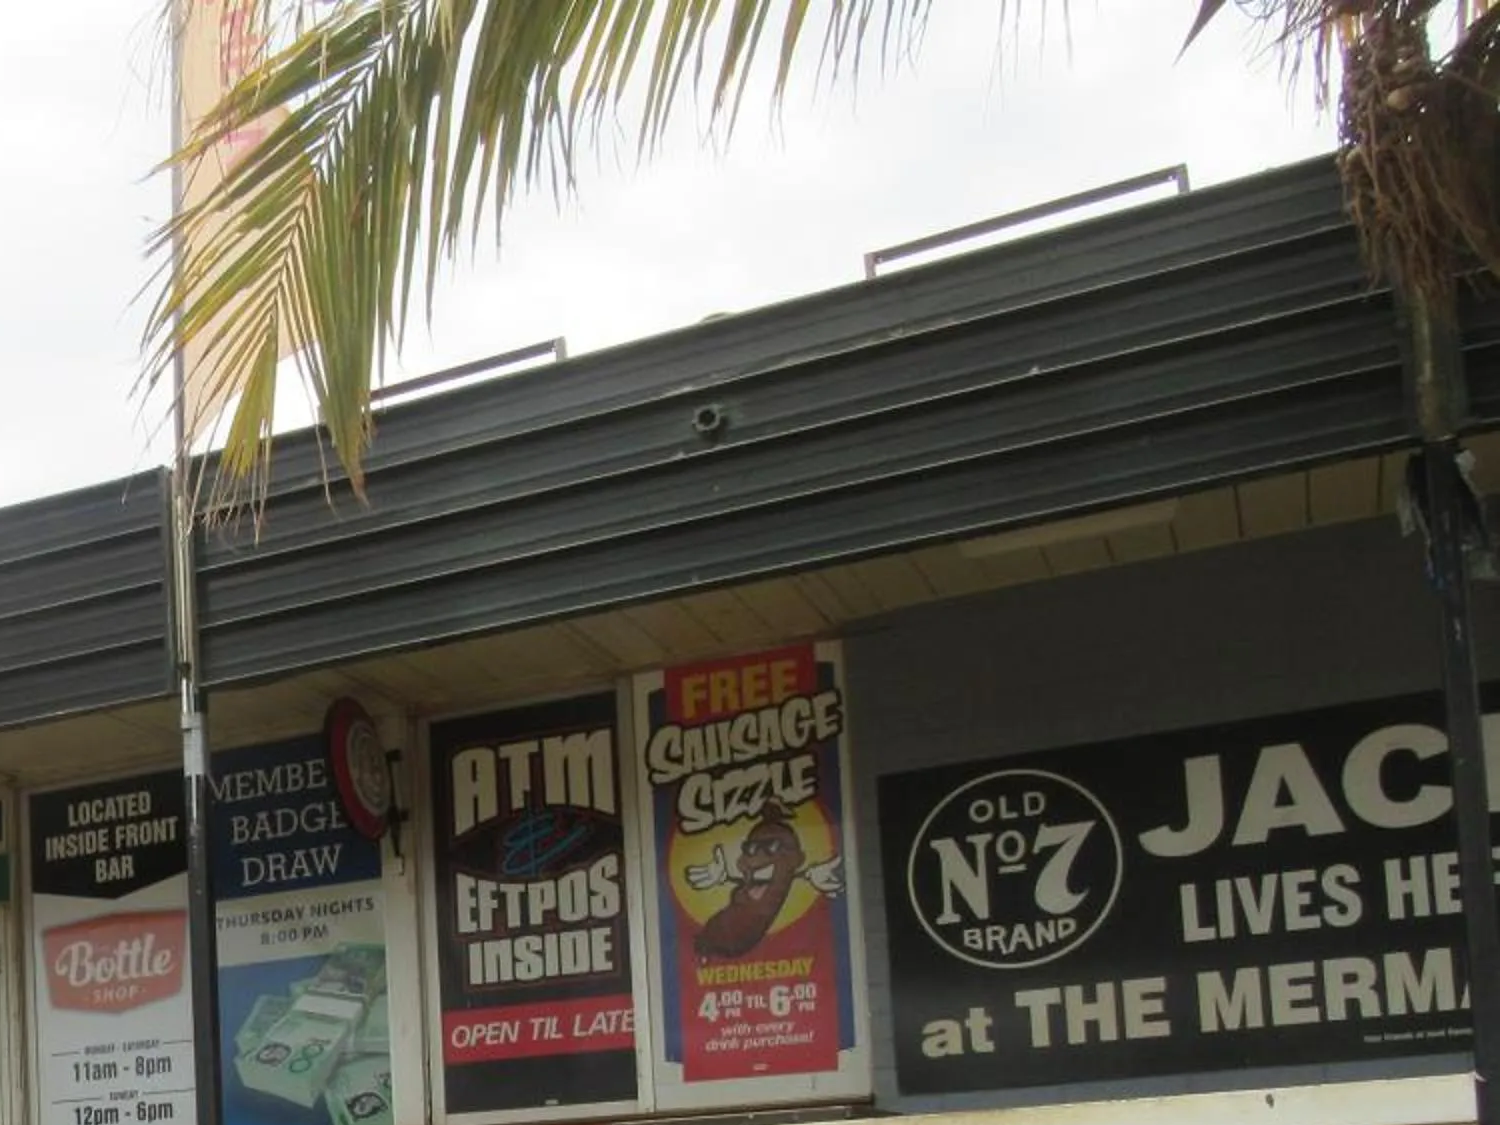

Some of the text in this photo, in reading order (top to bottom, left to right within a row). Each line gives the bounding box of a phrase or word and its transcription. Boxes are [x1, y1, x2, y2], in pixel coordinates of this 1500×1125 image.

[681, 659, 798, 721] FREE
[648, 690, 844, 786] SAUSAGE
[206, 758, 328, 804] MEMBE
[450, 728, 617, 837] ATM
[677, 753, 818, 834] SIZZLE
[1138, 723, 1500, 858] JAC
[67, 790, 152, 828] LOCATED
[968, 790, 1046, 824] OLD
[45, 816, 179, 862] INSIDE FRONT
[95, 855, 136, 884] BAR
[241, 843, 344, 888] DRAW
[217, 897, 375, 931] THURSDAY NIGHTS
[454, 852, 621, 938] EFTPOS
[1179, 862, 1363, 944] LIVES
[302, 923, 330, 941] PM
[962, 917, 1077, 955] BRAND
[54, 933, 176, 988] Bottle
[468, 925, 614, 986] INSIDE
[696, 956, 815, 987] WEDNESDAY
[93, 984, 139, 1003] SHOP
[920, 946, 1472, 1058] at THE MERM
[450, 1007, 635, 1049] OPEN TIL LATE
[73, 1061, 118, 1082] 11am
[135, 1055, 172, 1078] 8pm
[136, 1101, 174, 1123] 6pm
